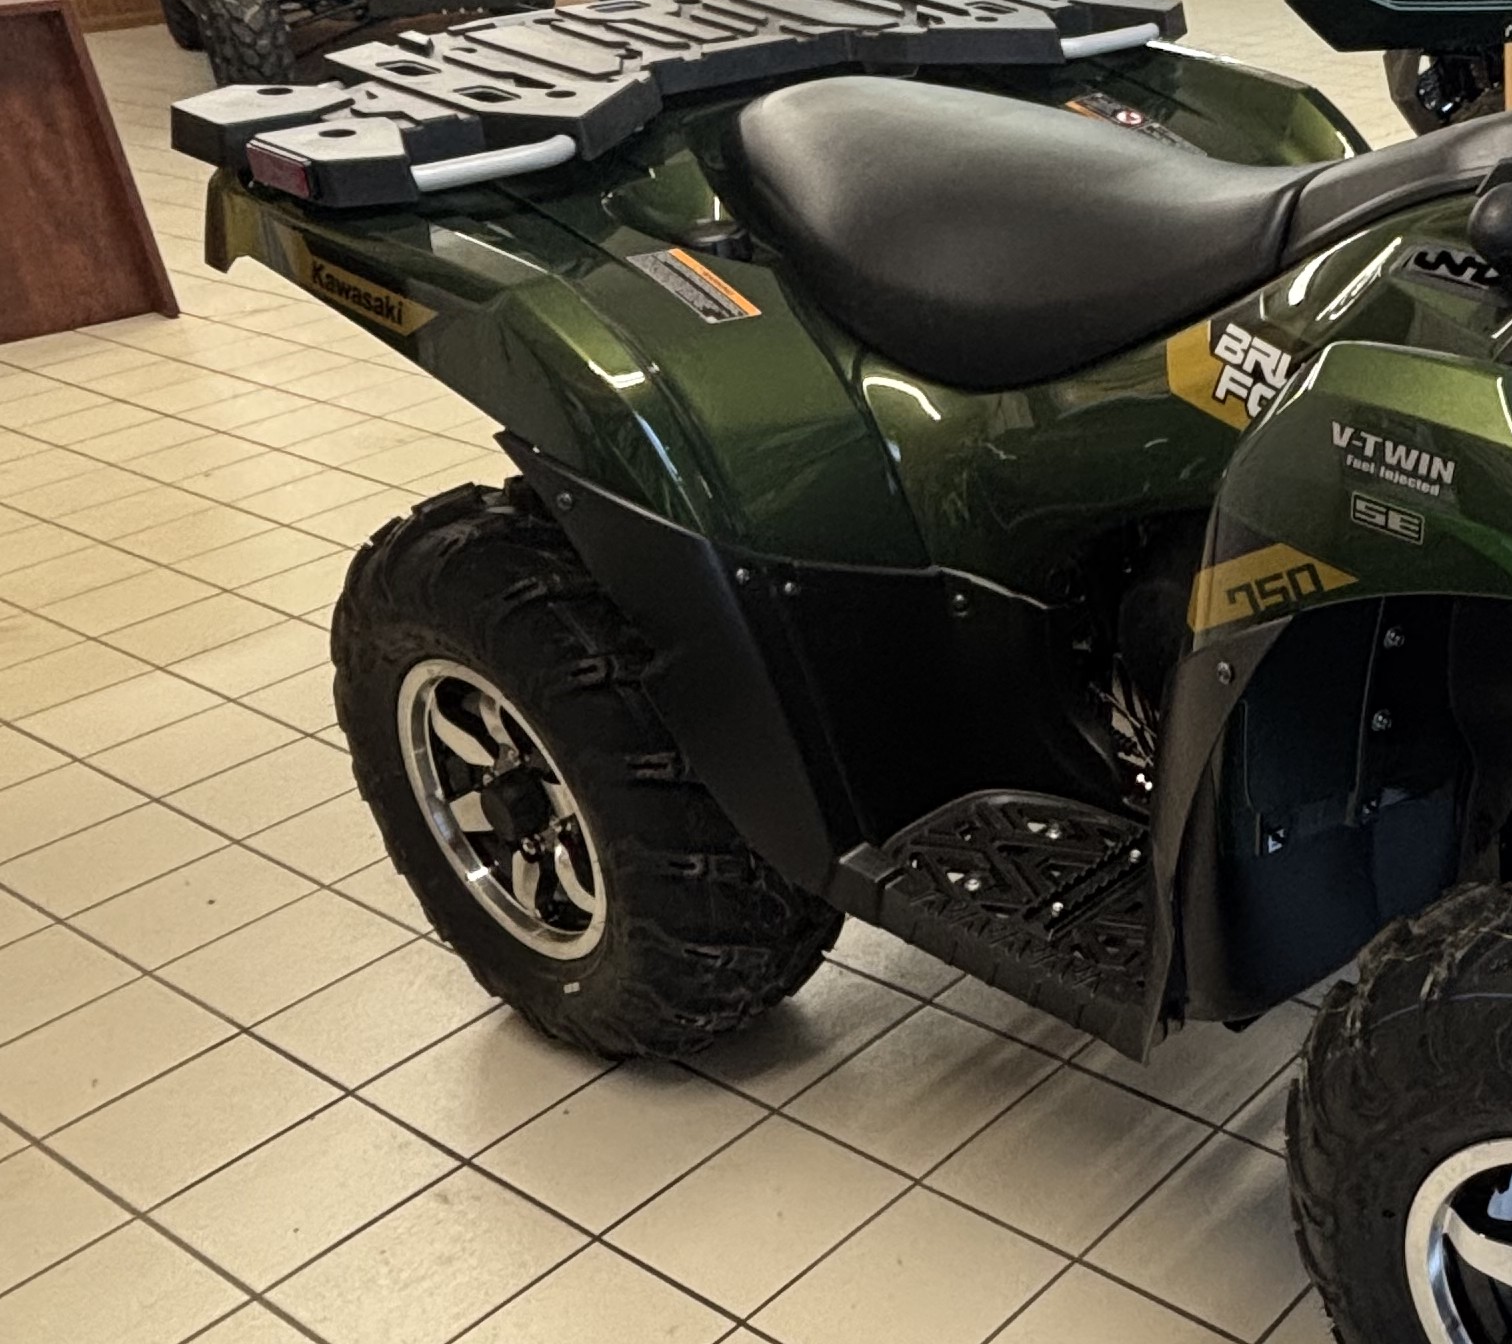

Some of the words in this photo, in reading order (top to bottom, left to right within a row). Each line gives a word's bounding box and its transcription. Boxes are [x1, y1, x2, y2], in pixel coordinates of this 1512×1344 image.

[310, 260, 404, 326] Kawasaki
[1332, 421, 1455, 485] V-TWIN
[1346, 454, 1376, 476] Fuel
[1379, 464, 1441, 498] Injected
[1353, 500, 1423, 542] SE
[1223, 563, 1324, 614] 750
